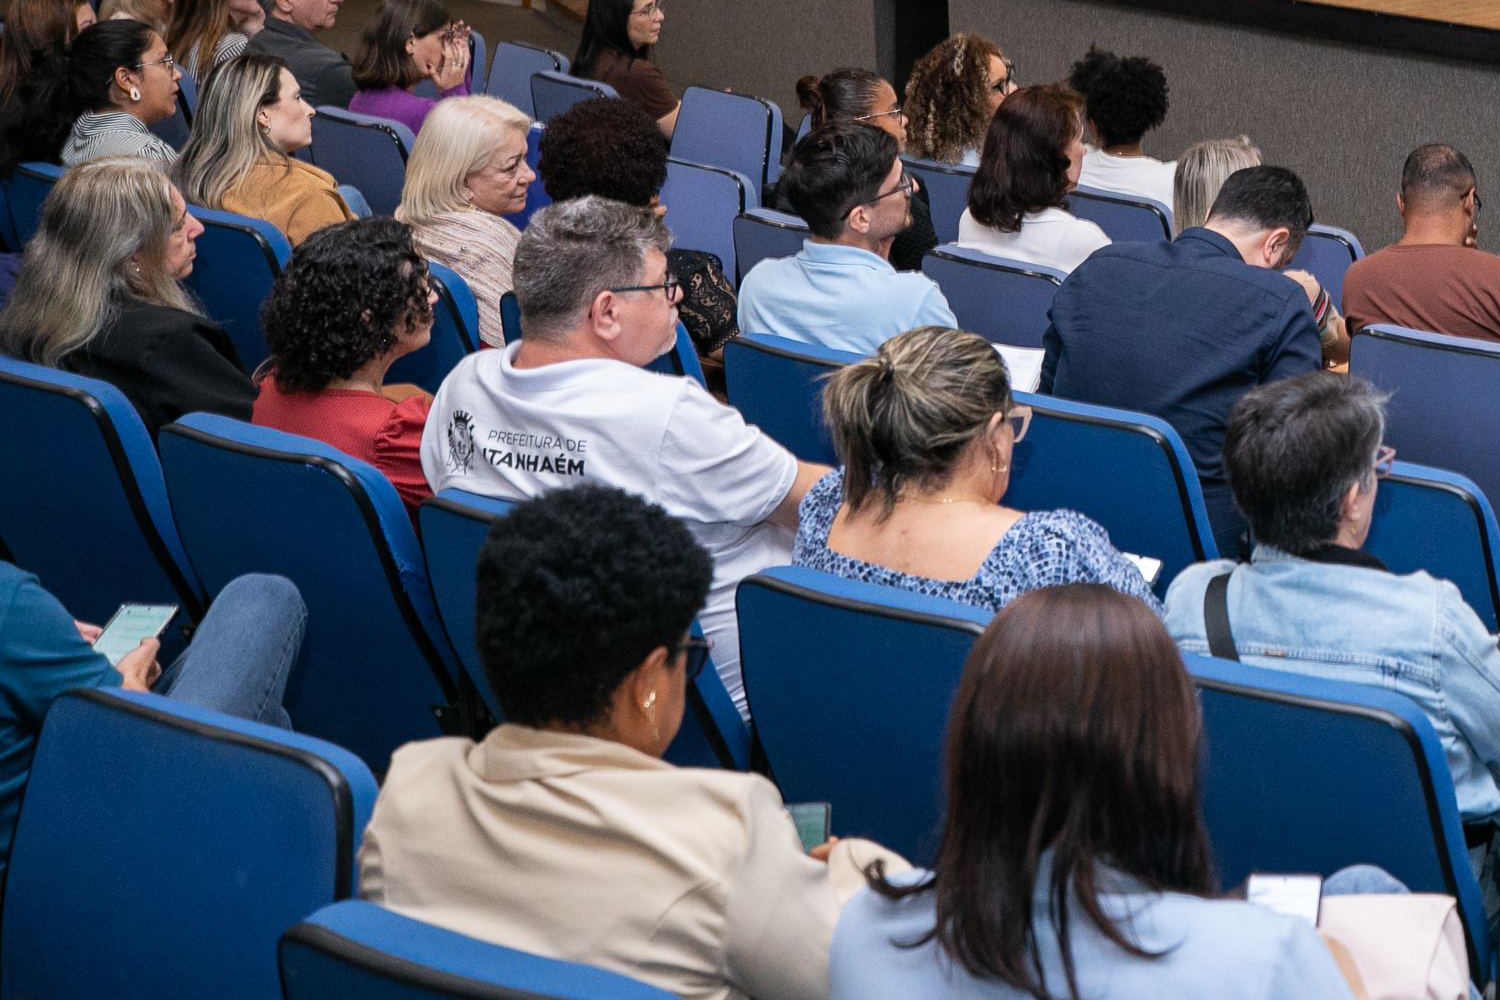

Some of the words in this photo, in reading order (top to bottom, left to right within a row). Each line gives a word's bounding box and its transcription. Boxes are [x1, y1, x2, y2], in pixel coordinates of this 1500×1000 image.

[487, 429, 563, 450] PREFEITURA
[566, 438, 588, 453] DE
[482, 447, 586, 477] ITANHAÉM
